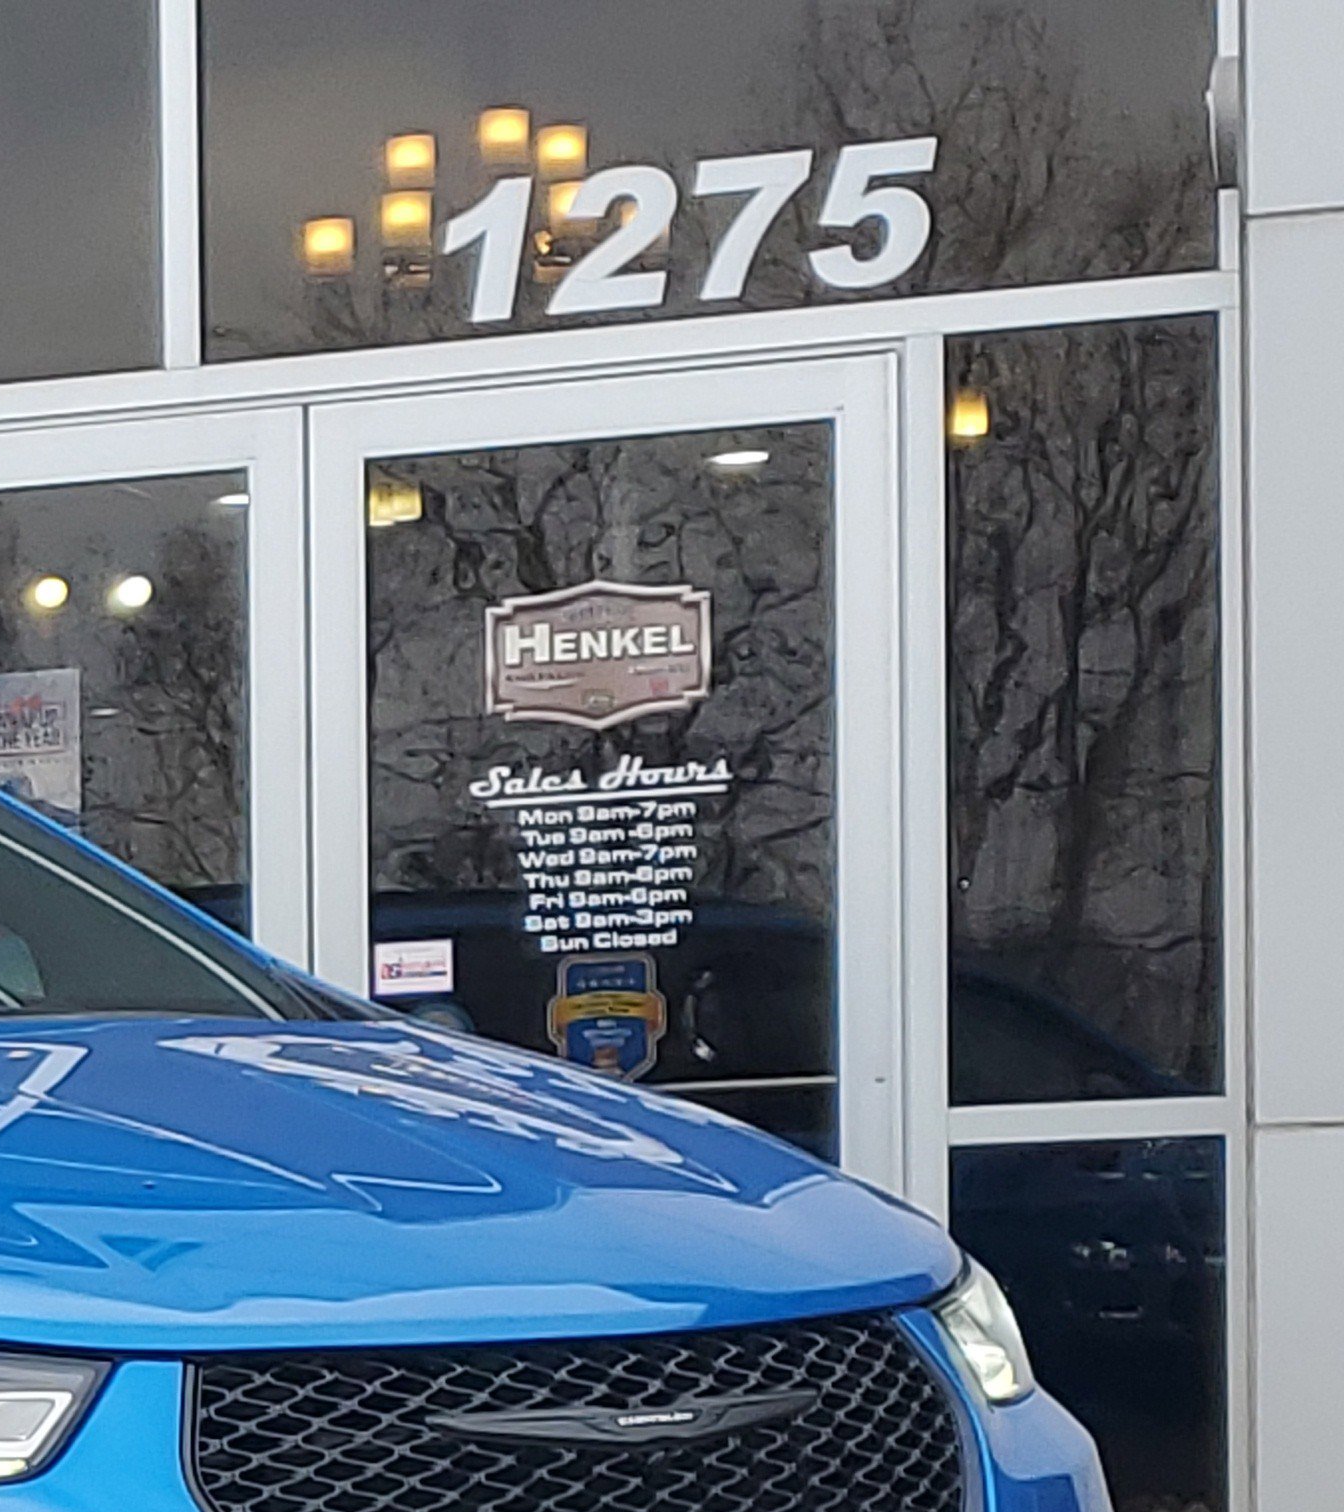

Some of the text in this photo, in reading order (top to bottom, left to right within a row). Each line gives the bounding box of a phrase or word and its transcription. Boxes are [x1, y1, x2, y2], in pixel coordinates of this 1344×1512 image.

[441, 136, 939, 324] 1275
[503, 622, 695, 667] HENKEL
[469, 754, 733, 797] Sales Hours
[518, 808, 573, 827] Mon
[521, 830, 566, 848] Tue
[518, 850, 574, 869] Wed
[522, 872, 570, 890] Thu
[529, 893, 564, 911] Fri
[524, 914, 570, 933] Sat
[540, 928, 678, 953] Sun Closed
